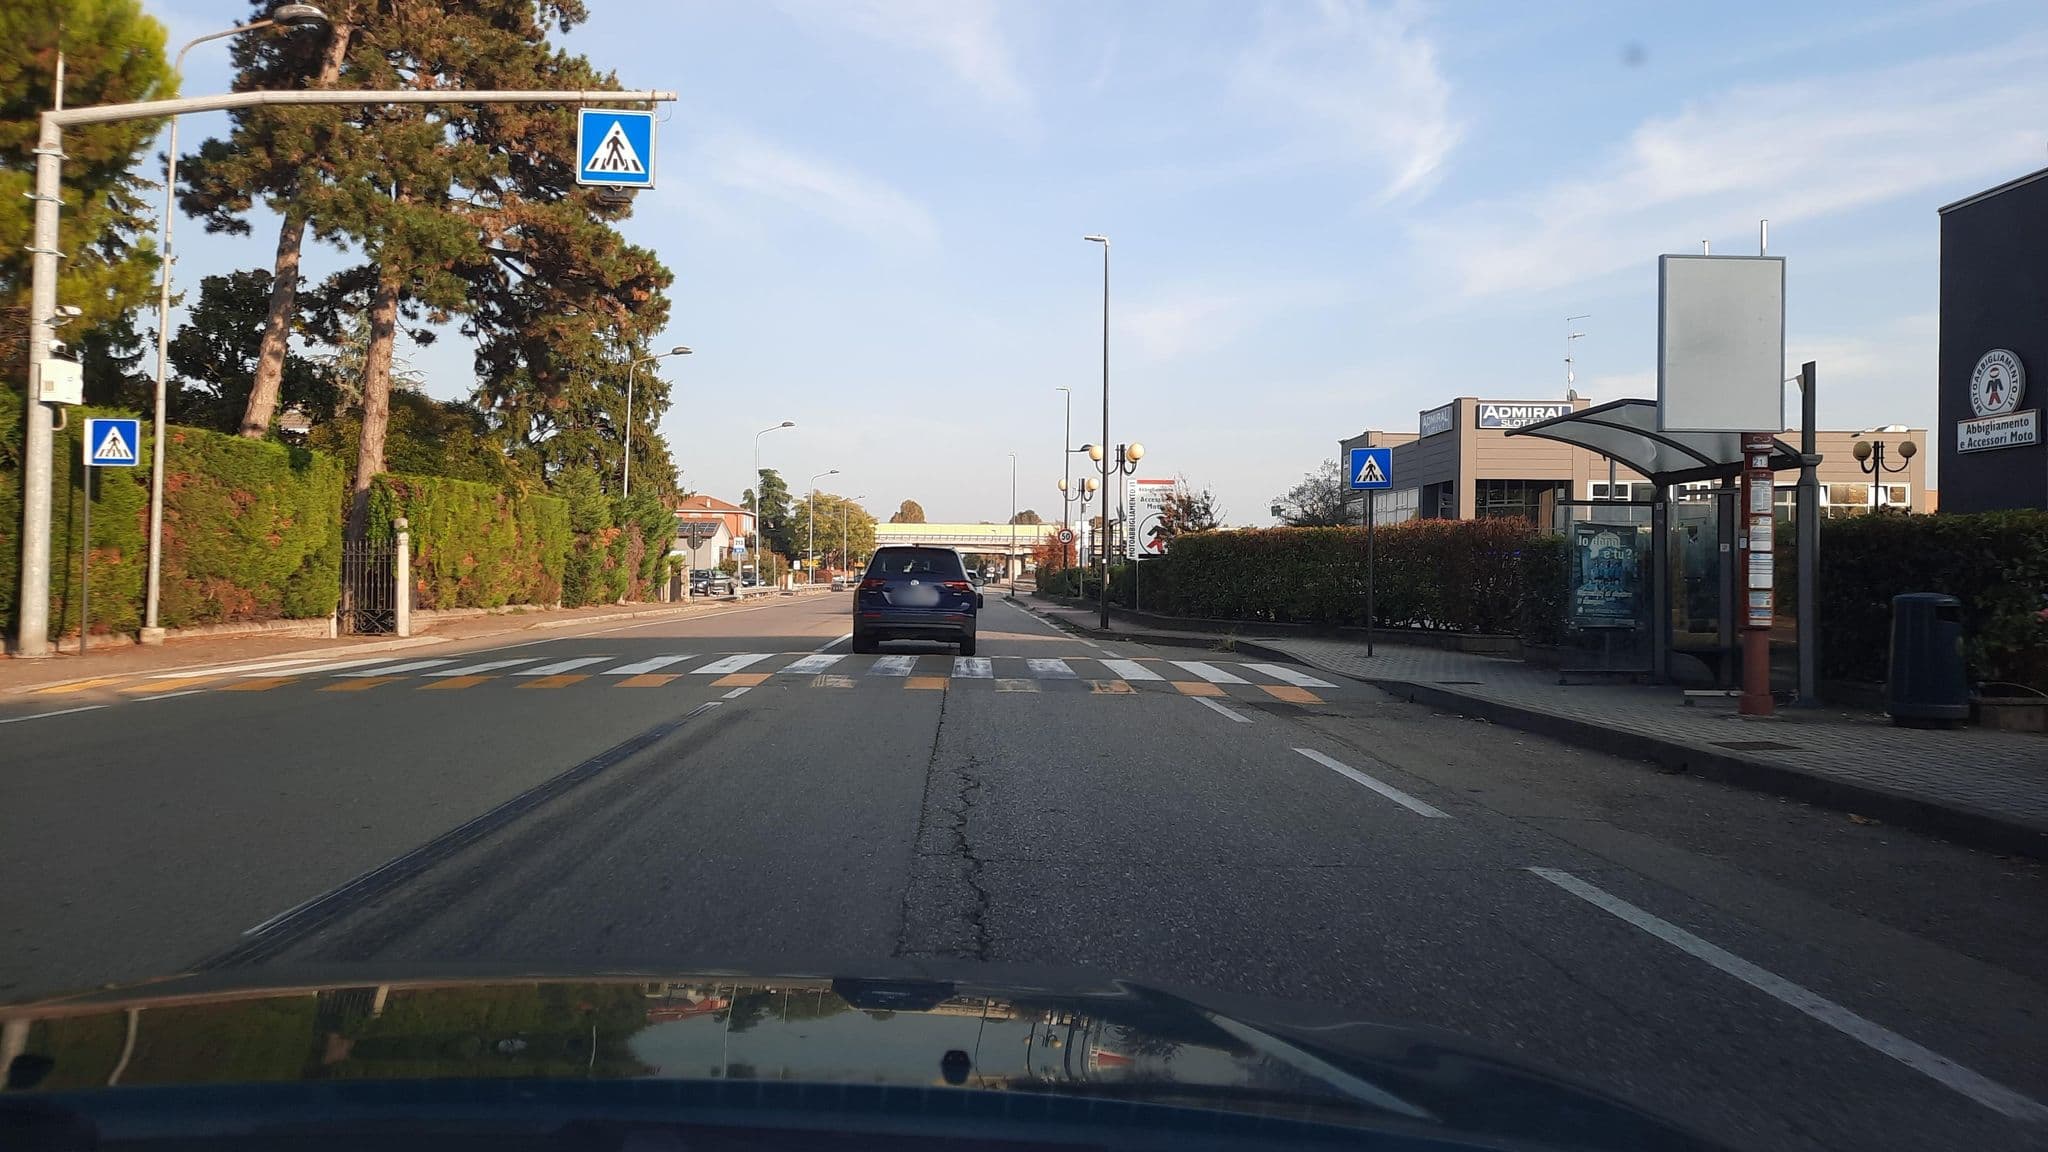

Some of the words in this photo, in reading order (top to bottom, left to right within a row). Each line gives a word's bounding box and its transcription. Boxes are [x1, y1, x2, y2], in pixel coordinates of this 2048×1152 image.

[1972, 353, 2018, 414] MOTOABBIGLIAMENTO.IT
[1501, 419, 1528, 428] SLOT
[1966, 418, 2029, 436] Abbigliamento
[1960, 441, 1965, 449] e
[1967, 432, 2007, 449] Accessori
[2010, 430, 2033, 443] Moto
[1061, 532, 1071, 540] 50
